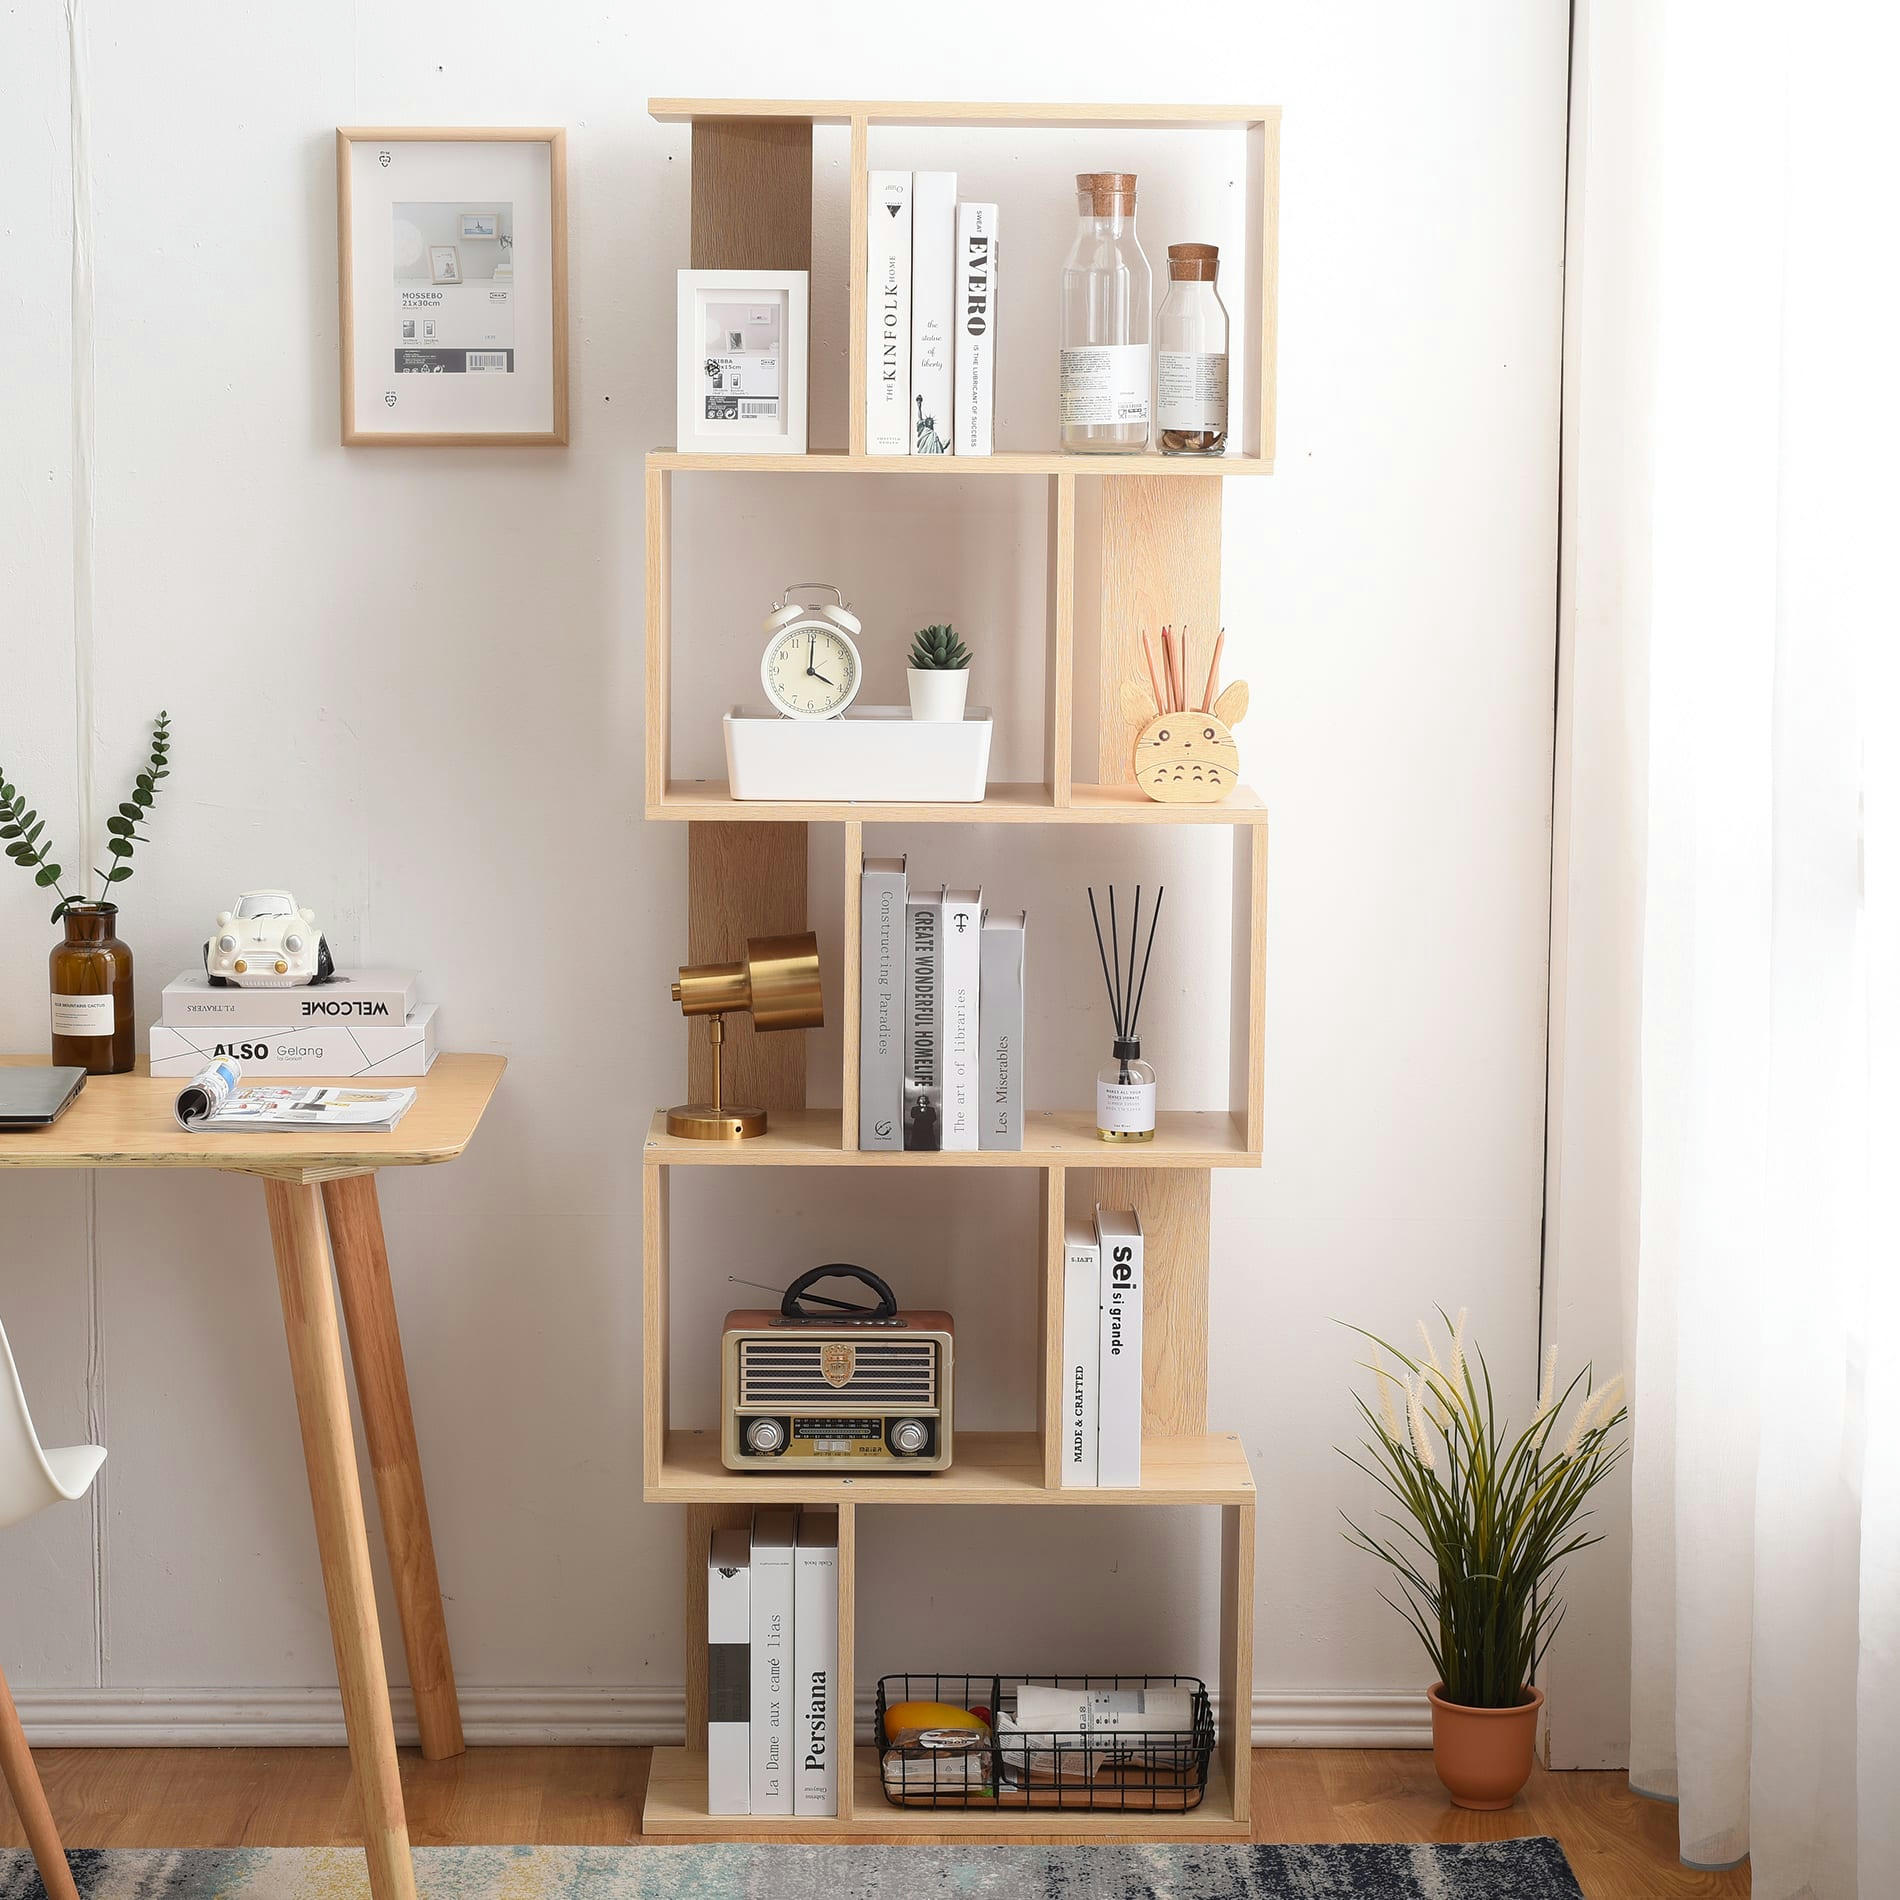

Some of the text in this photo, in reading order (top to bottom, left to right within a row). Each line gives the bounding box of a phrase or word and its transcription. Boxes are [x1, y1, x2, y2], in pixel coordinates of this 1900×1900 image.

[975, 210, 983, 233] SWEAT
[966, 236, 989, 337] EVERO
[402, 292, 443, 300] MOSSEBO
[402, 299, 441, 307] 21x30cm
[883, 255, 898, 402] THE KINFOLK HOME
[927, 319, 938, 328] the
[927, 346, 936, 358] of
[972, 344, 980, 352] IS
[921, 358, 943, 371] liberty
[971, 405, 978, 415] OF
[970, 416, 978, 448] SUCCESS
[791, 638, 799, 649] 11
[807, 633, 817, 643] 12
[779, 650, 789, 661] 10
[838, 650, 845, 660] 2
[772, 666, 780, 676] 9
[843, 667, 850, 677] 3
[778, 683, 785, 692] 8
[837, 684, 844, 693] 4
[791, 694, 798, 705] 7
[806, 699, 815, 710] 6
[825, 696, 832, 706] 5
[877, 890, 894, 1055] Constructing Paradies
[913, 910, 935, 1087] CREATE WONDERFUL HOMELIFE
[301, 1001, 389, 1016] WELCOME
[212, 1041, 324, 1060] ALSO Gelang
[953, 988, 966, 1134] The art of libraries
[995, 1035, 1009, 1134] Les Miserables
[1108, 1246, 1137, 1356] sei si grande
[1073, 1365, 1084, 1463] MADE & CRAFTED
[765, 1614, 781, 1796] La Dame aux camé lias
[804, 1670, 827, 1772] Persiana
